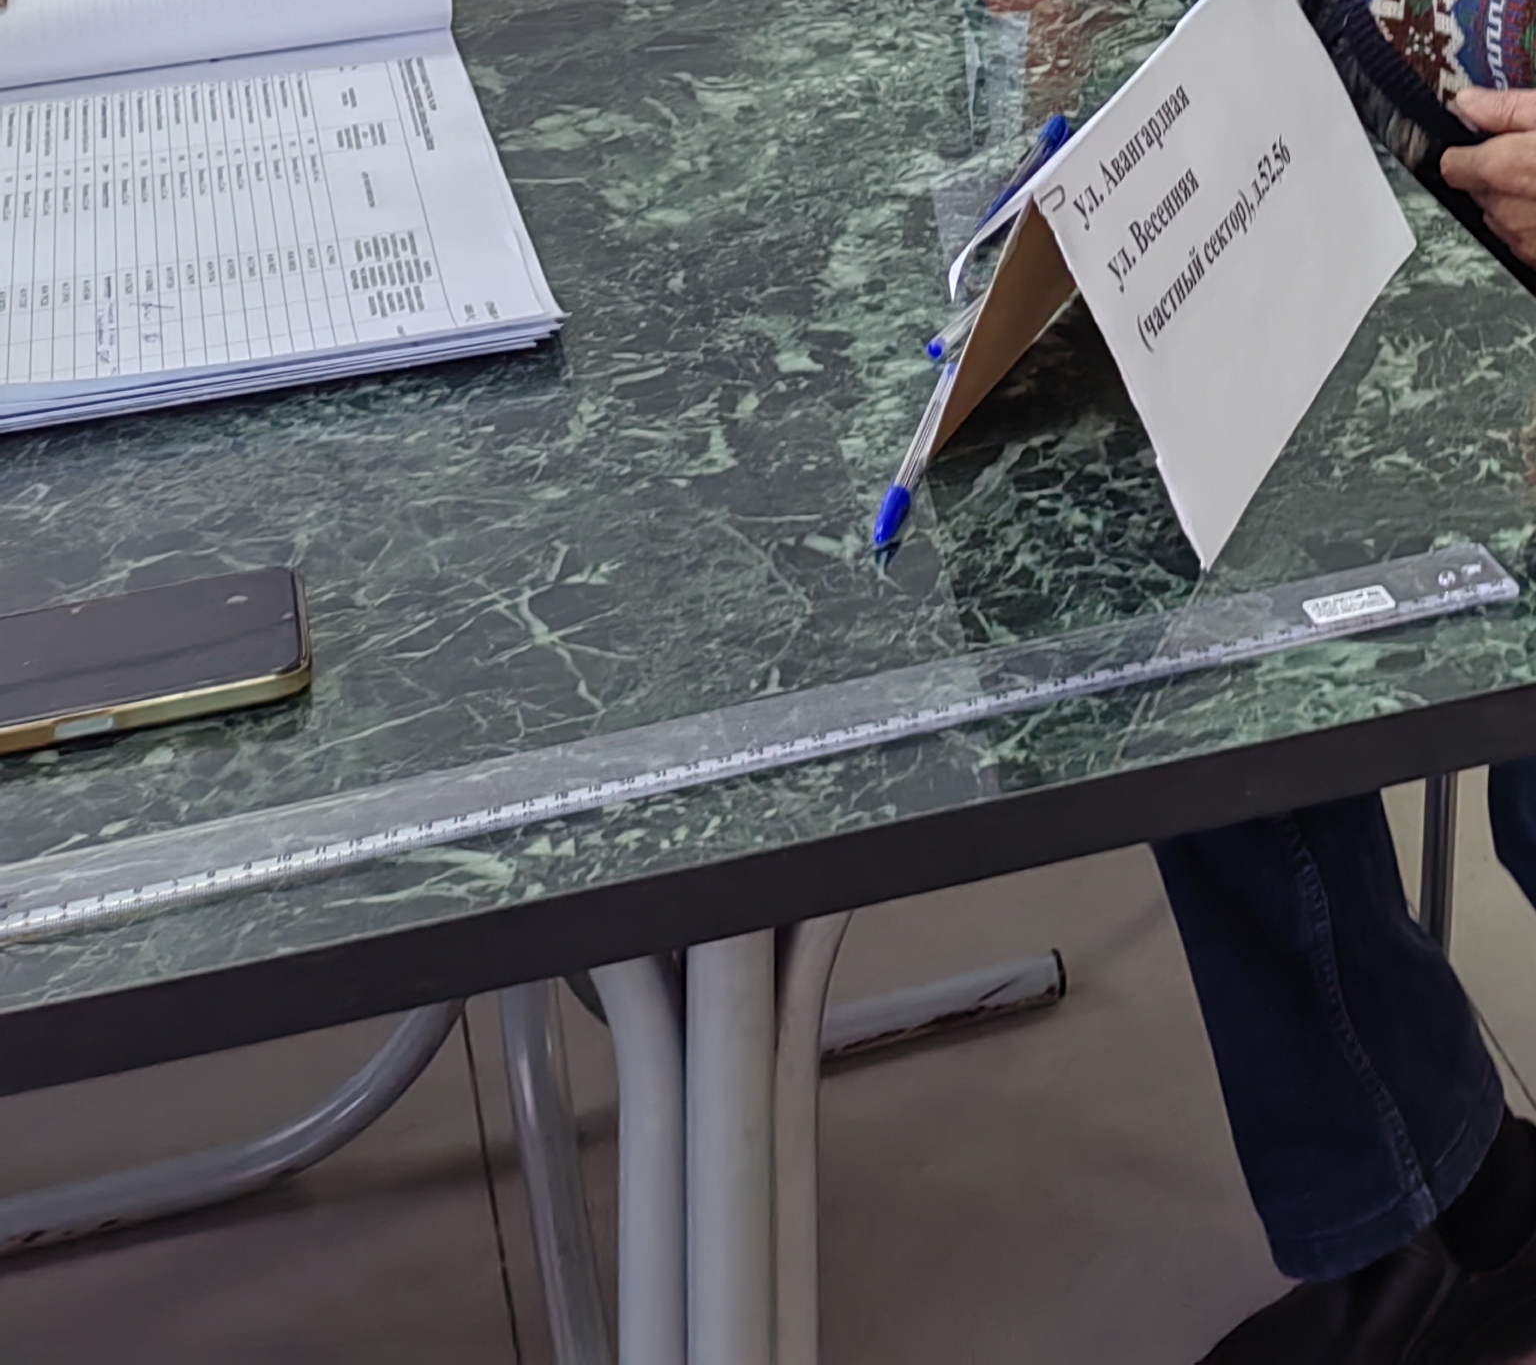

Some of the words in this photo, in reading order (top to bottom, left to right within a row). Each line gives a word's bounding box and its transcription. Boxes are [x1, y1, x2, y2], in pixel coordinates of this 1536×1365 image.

[1072, 184, 1105, 232] ул.
[1099, 84, 1191, 195] Авангардная
[1106, 246, 1138, 295] ул.
[1128, 167, 1200, 257] Весенняя
[1136, 244, 1206, 355] (частный
[1202, 188, 1257, 266] сектор),
